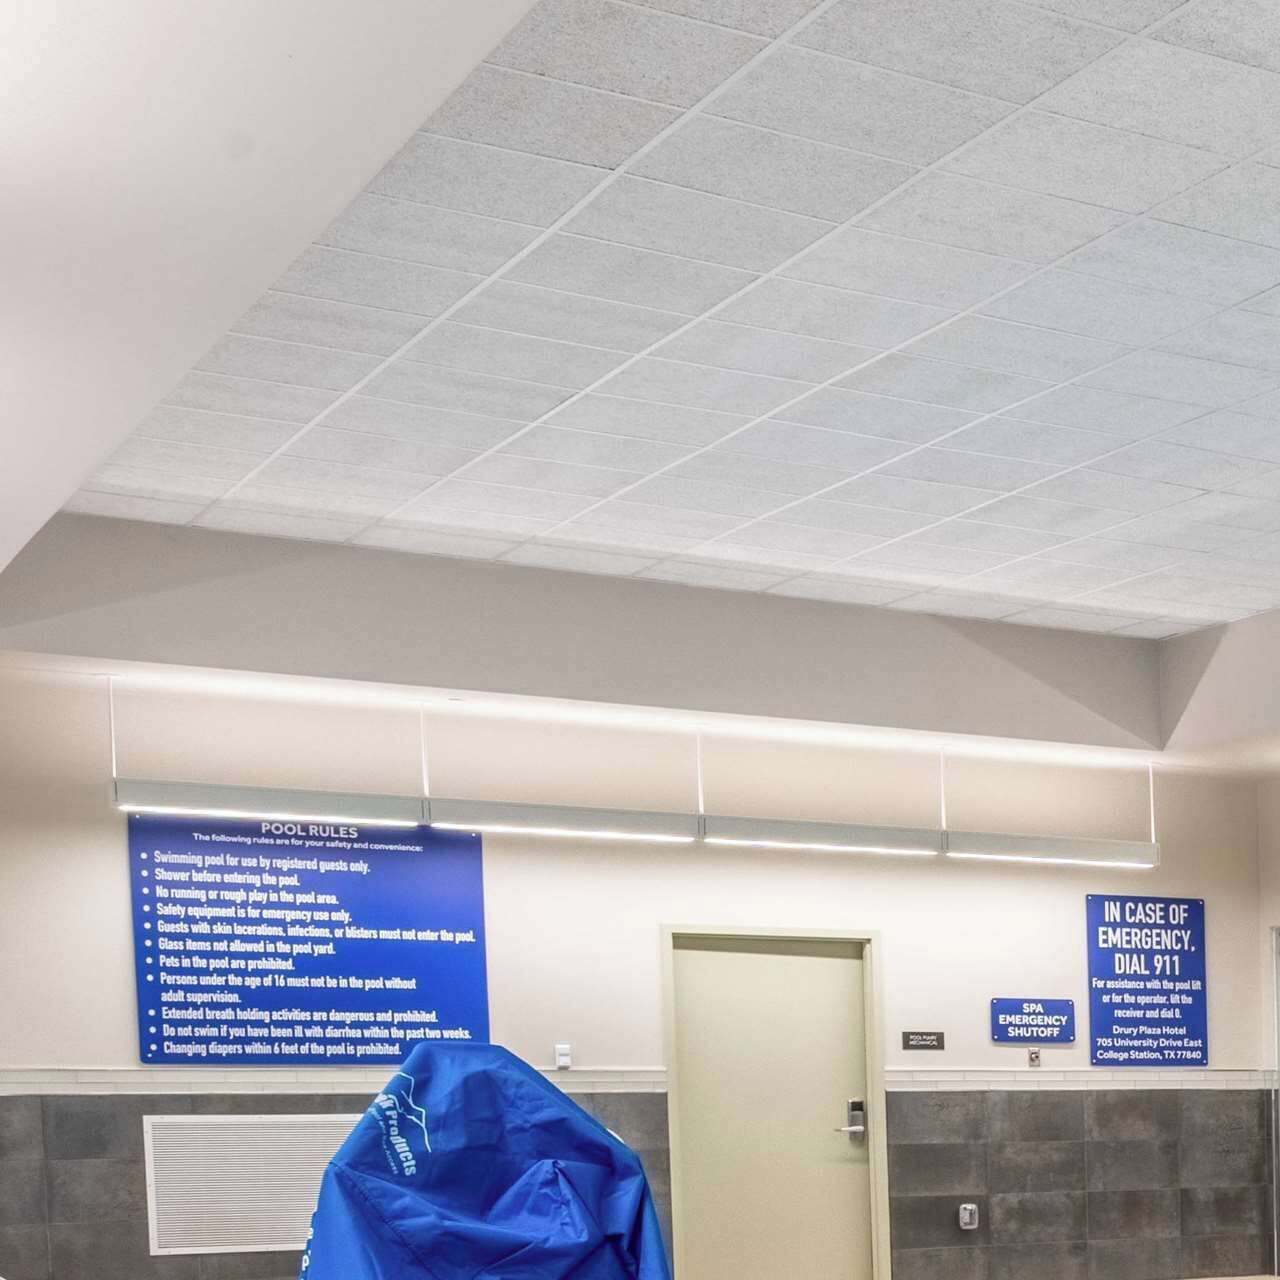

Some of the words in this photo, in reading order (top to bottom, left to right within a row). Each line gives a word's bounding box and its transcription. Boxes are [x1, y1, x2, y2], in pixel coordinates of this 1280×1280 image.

[262, 823, 306, 836] POOL
[310, 825, 358, 838] RULES
[154, 851, 203, 867] Swimming
[205, 853, 224, 868] pool
[226, 854, 239, 866] for
[241, 857, 257, 867] use
[259, 855, 271, 870] by
[272, 856, 317, 873] registered
[319, 858, 348, 874] guests
[350, 860, 371, 875] only.
[155, 868, 190, 881] Shower
[192, 870, 221, 883] before
[224, 871, 261, 887] entering
[262, 872, 277, 885] the
[279, 873, 301, 888] pool.
[156, 886, 169, 898] No
[171, 886, 207, 902] running
[208, 890, 218, 900] or
[220, 888, 247, 903] rough
[249, 889, 268, 904] play
[269, 890, 278, 902] in
[280, 890, 294, 902] the
[296, 891, 315, 906] pool
[317, 894, 340, 904] area.
[157, 903, 186, 919] Safety
[187, 904, 236, 920] equipment
[237, 906, 246, 918] is
[247, 906, 261, 918] for
[262, 909, 312, 923] emergency
[313, 911, 329, 921] use
[331, 909, 353, 924] only.
[1105, 901, 1120, 922] IN
[1125, 902, 1165, 924] CASE
[1169, 904, 1188, 925] OF
[158, 920, 189, 933] Guests
[191, 921, 210, 934] with
[212, 922, 232, 934] skin
[334, 928, 344, 938] or
[345, 926, 378, 939] blisters
[379, 927, 400, 940] must
[402, 928, 416, 940] not
[417, 928, 439, 941] enter
[440, 929, 454, 941] the
[455, 929, 476, 945] pool.
[1098, 927, 1195, 952] EMERGENCY,
[160, 955, 180, 968] Pets
[182, 956, 190, 968] in
[192, 956, 207, 968] the
[209, 956, 229, 971] pool
[231, 959, 246, 969] are
[248, 957, 296, 973] prohibited.
[1115, 953, 1150, 974] DIAL
[1154, 955, 1179, 975] 911
[160, 973, 198, 985] Persons
[200, 973, 226, 986] under
[228, 974, 243, 986] the
[244, 977, 261, 989] age
[263, 975, 272, 987] of
[274, 975, 285, 987] 16
[287, 975, 309, 987] must
[310, 976, 325, 988] not
[326, 976, 337, 988] be
[339, 976, 348, 988] in
[349, 977, 363, 989] the
[365, 977, 384, 992] pool
[385, 977, 416, 990] without
[1092, 978, 1105, 988] For
[1106, 979, 1144, 989] assistance
[1146, 979, 1161, 989] with
[1163, 980, 1174, 989] the
[1175, 980, 1190, 991] pool
[1192, 980, 1201, 990] lift
[161, 990, 185, 1002] adult
[186, 990, 242, 1006] supervision.
[1102, 995, 1111, 1003] or
[1112, 993, 1123, 1003] for
[1124, 993, 1135, 1003] the
[1170, 994, 1180, 1003] lift
[1181, 994, 1192, 1004] the
[162, 1007, 204, 1020] Extended
[205, 1008, 235, 1020] breath
[237, 1008, 270, 1023] holding
[272, 1009, 311, 1021] activities
[313, 1012, 327, 1021] are
[329, 1009, 374, 1024] dangerous
[376, 1010, 392, 1022] and
[394, 1010, 439, 1025] prohibited.
[1023, 1003, 1044, 1013] SPA
[1114, 1008, 1144, 1017] receiver
[1145, 1008, 1159, 1018] and
[1161, 1008, 1173, 1018] dial
[1175, 1009, 1182, 1018] 0.
[999, 1015, 1068, 1025] EMERGENCY
[163, 1025, 175, 1037] Do
[178, 1025, 192, 1037] not
[194, 1025, 219, 1037] swim
[220, 1026, 227, 1037] if
[229, 1028, 245, 1040] you
[247, 1026, 269, 1038] have
[271, 1026, 293, 1038] been
[294, 1026, 303, 1038] ill
[304, 1026, 323, 1038] with
[325, 1026, 362, 1038] diarrhea
[363, 1026, 389, 1038] within
[391, 1027, 404, 1038] the
[406, 1027, 424, 1041] past
[425, 1027, 441, 1039] two
[442, 1027, 472, 1039] weeks.
[1008, 1026, 1060, 1037] SHUTOFF
[1113, 1026, 1138, 1036] Drury
[1139, 1026, 1161, 1034] Plaza
[1163, 1026, 1186, 1035] Hotel
[164, 1042, 207, 1057] Changing
[209, 1042, 243, 1057] diapers
[244, 1042, 272, 1054] within
[274, 1043, 280, 1054] 6
[281, 1043, 298, 1054] feet
[300, 1043, 309, 1054] of
[311, 1043, 325, 1054] the
[326, 1043, 345, 1057] pool
[347, 1043, 355, 1055] is
[357, 1043, 402, 1057] prohibited.
[1096, 1038, 1112, 1046] 705
[1114, 1038, 1158, 1048] University
[1159, 1039, 1182, 1047] Drive
[1184, 1039, 1202, 1047] East
[1097, 1050, 1129, 1060] College
[1130, 1051, 1162, 1060] Station,
[1164, 1051, 1175, 1059] TX
[1177, 1051, 1201, 1059] 77840
[385, 1110, 416, 1176] Products
